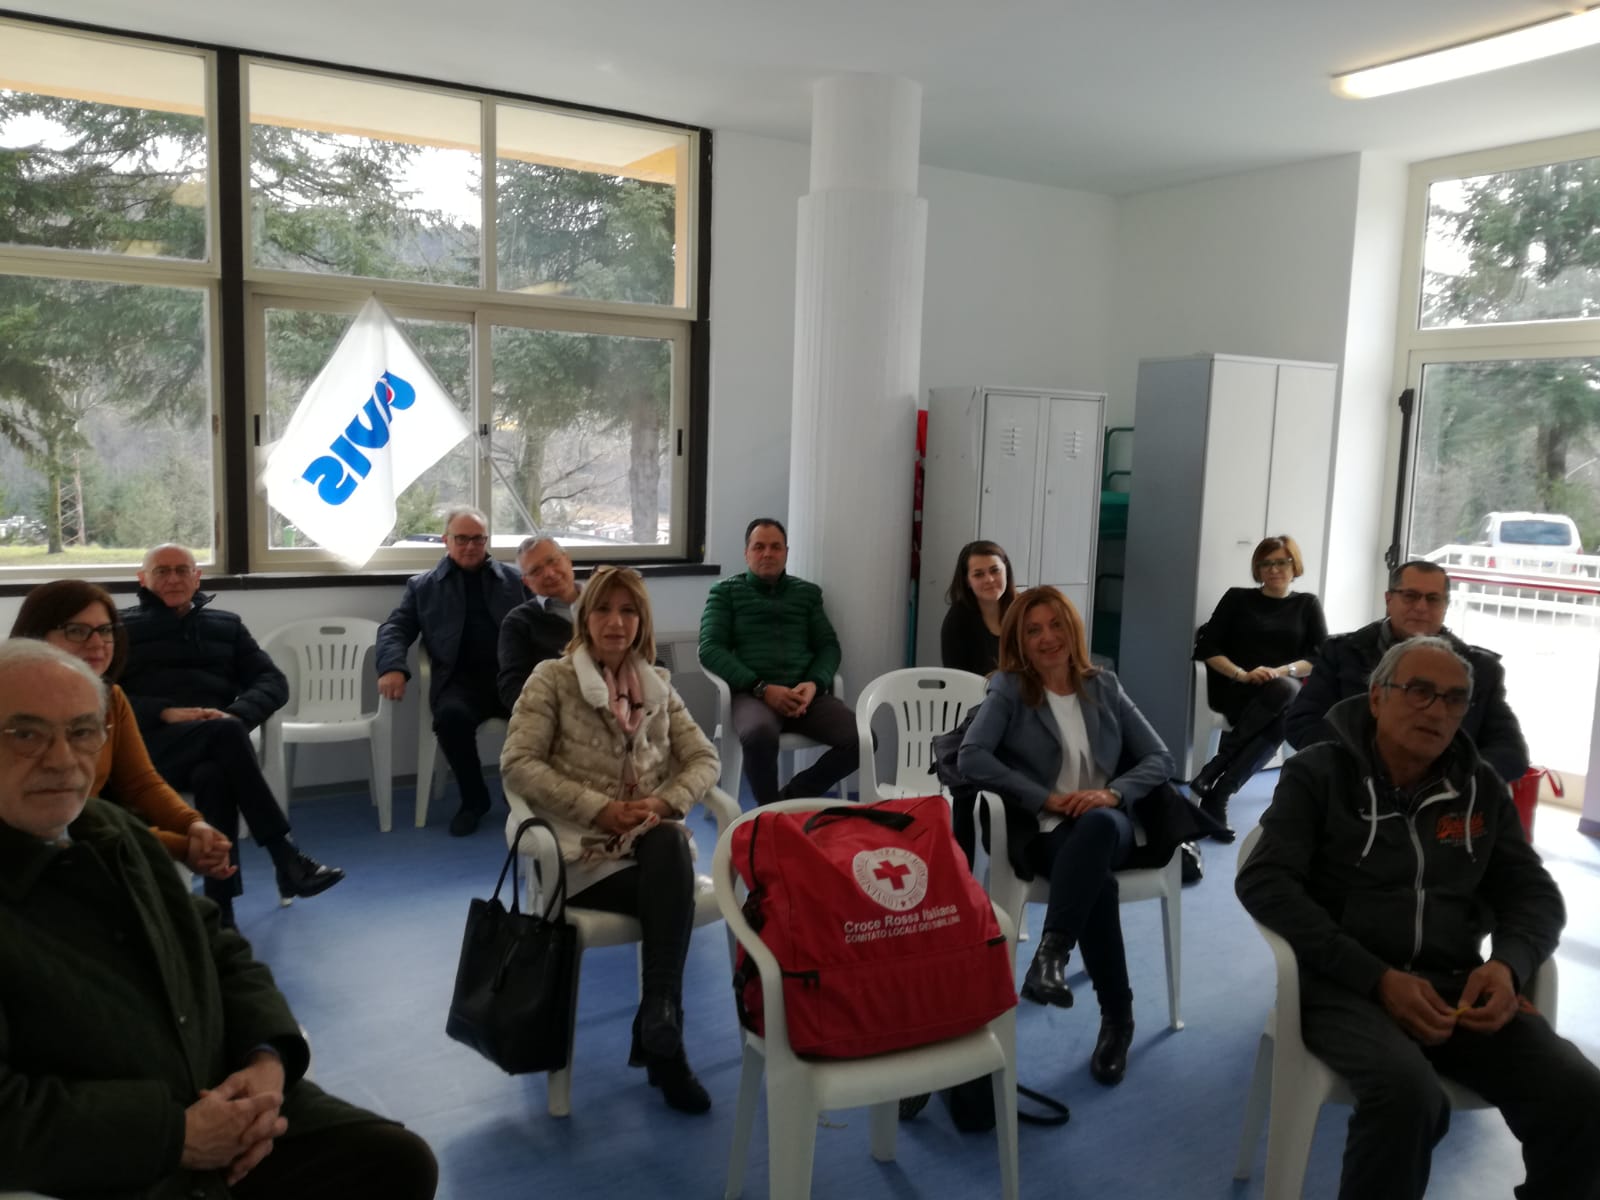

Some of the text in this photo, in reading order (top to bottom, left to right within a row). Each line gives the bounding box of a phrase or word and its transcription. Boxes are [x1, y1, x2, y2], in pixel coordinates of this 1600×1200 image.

[844, 904, 958, 934] Croce Rossa Italiana
[845, 929, 887, 944] COMITATO
[888, 925, 917, 938] LOCALE
